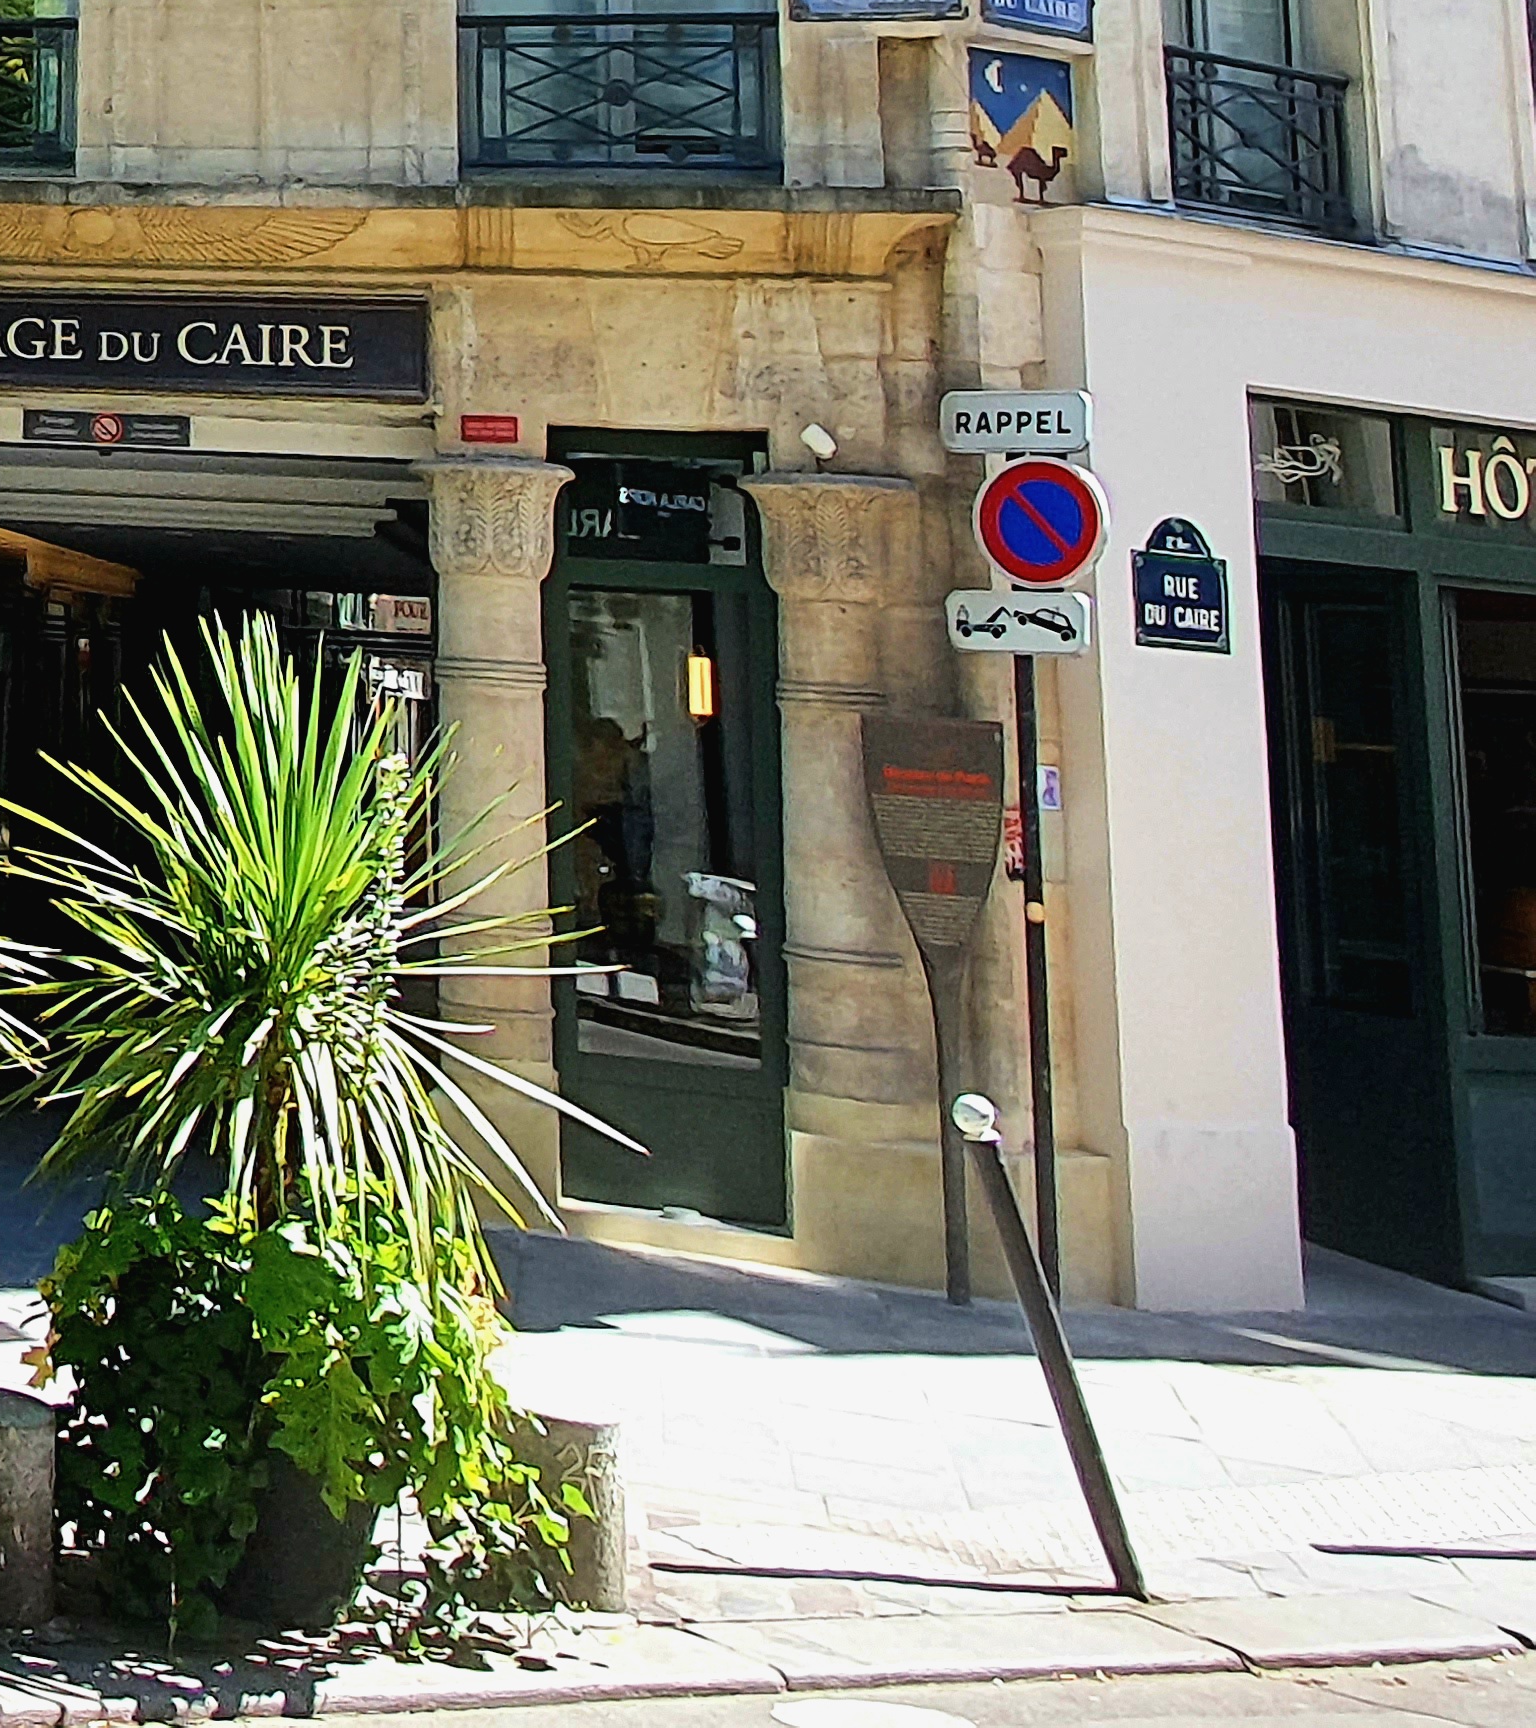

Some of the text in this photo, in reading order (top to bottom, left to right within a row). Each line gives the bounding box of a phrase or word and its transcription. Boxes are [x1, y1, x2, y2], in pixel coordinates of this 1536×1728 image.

[97, 331, 162, 363] DU
[177, 322, 354, 368] CAIRE
[955, 410, 1072, 434] RAPPEL
[1439, 435, 1536, 520] HÔ
[1163, 574, 1199, 600] RUE
[1145, 602, 1220, 632] DU CAIRE
